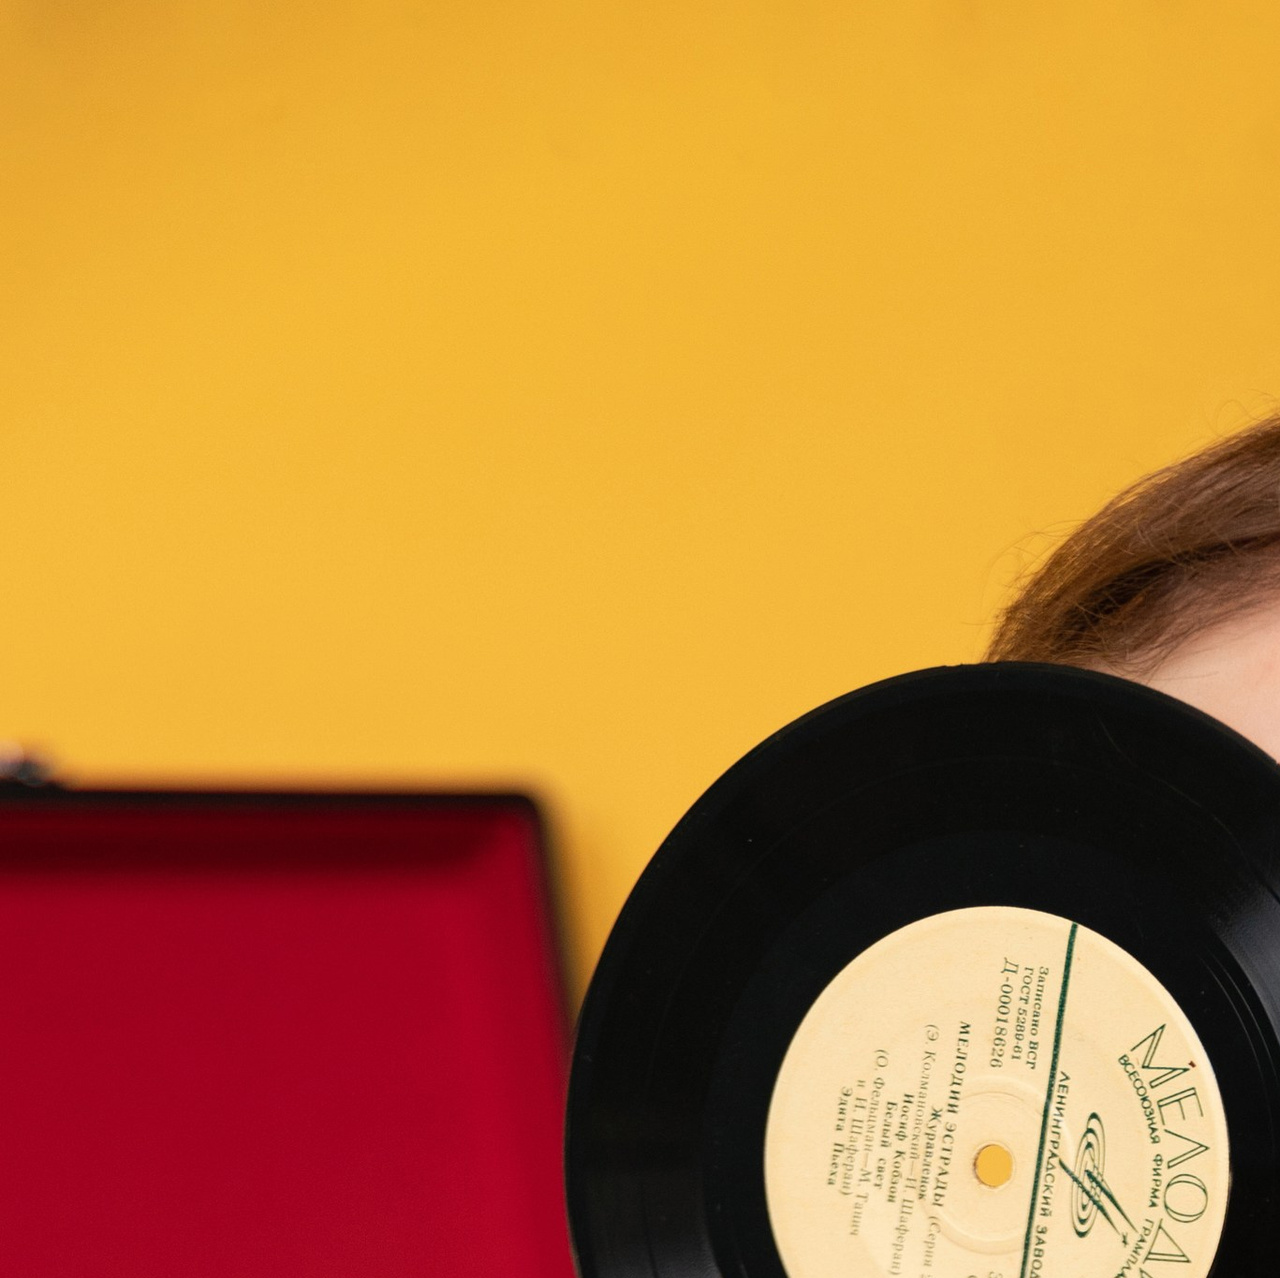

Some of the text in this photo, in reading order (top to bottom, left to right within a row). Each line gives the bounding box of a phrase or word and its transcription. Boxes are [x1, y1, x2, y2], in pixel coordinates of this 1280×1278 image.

[924, 1024, 939, 1046] (Э.
[990, 957, 1019, 1068] Д-00018626
[1011, 967, 1034, 1060] ГОСТ 5289-61
[1026, 966, 1049, 1070] Записано ВСГ
[853, 1097, 867, 1113] И.
[873, 1049, 888, 1073] (О.
[946, 1021, 971, 1114] МЕЛОДИИ
[826, 1089, 852, 1187] Эдита Пьеха
[839, 1118, 864, 1196] Шаферан)
[873, 1101, 898, 1189] Белый свет
[886, 1093, 915, 1204] Иосиф Кобзон
[918, 1107, 943, 1200] Журавленок
[932, 1122, 955, 1207] ЭСТРАДЫ
[1040, 1071, 1071, 1217] ЛЕНИНГРАДСКИЙ
[1118, 1054, 1161, 1144] ВСЕСОЮЗНАЯ
[1148, 1153, 1164, 1208] ФИРМА
[848, 1193, 870, 1238] Танич
[889, 1198, 914, 1276] Шаферан)
[923, 1215, 941, 1267] (Серия
